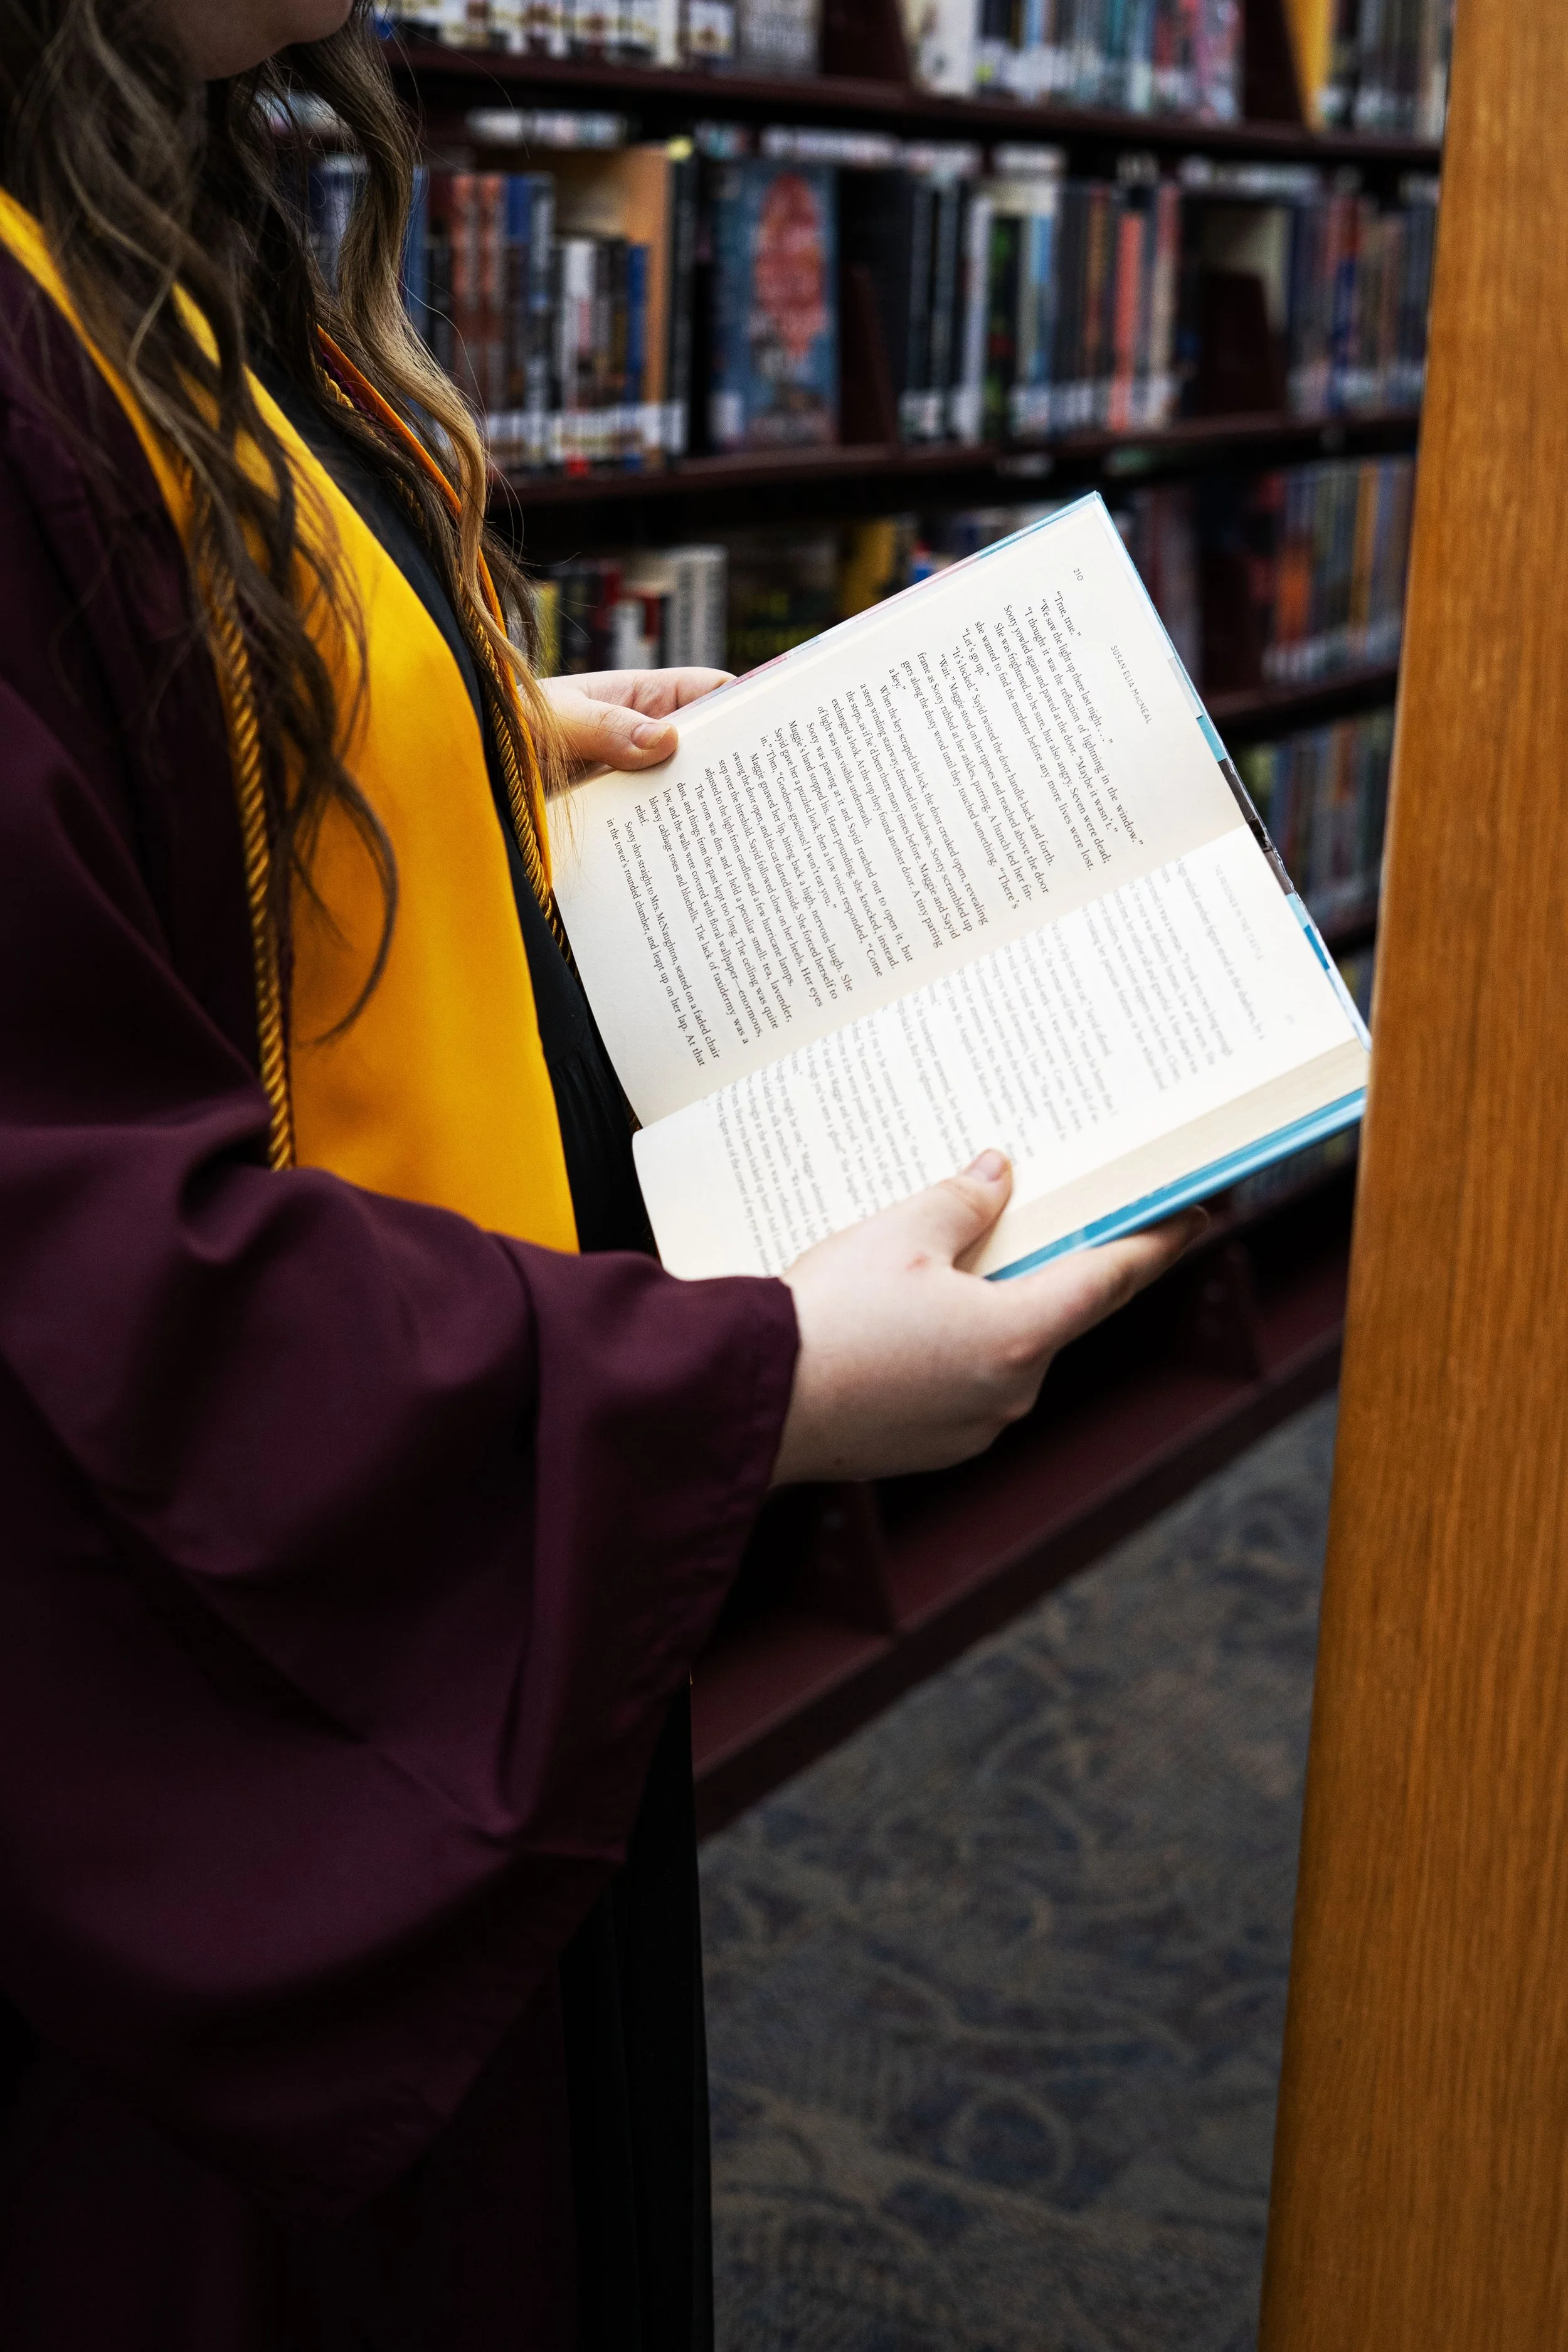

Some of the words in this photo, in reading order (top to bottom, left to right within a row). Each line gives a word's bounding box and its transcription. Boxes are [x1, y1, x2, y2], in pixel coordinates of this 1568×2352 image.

[1073, 568, 1083, 581] 210
[1004, 605, 1017, 627] Sooty
[1024, 607, 1032, 617] “I
[1054, 591, 1066, 618] “True,
[1064, 617, 1081, 636] true.”
[962, 628, 976, 652] “Let’s
[1010, 627, 1032, 654] yowled
[1027, 618, 1046, 647] thought
[968, 652, 979, 662] go
[1042, 647, 1050, 655] it
[974, 662, 989, 676] up.”
[1025, 654, 1040, 674] again
[1040, 598, 1050, 617] “We
[1046, 617, 1056, 631] saw
[1052, 632, 1062, 645] the
[1058, 643, 1071, 662] light
[1066, 662, 1075, 672] up
[1072, 673, 1084, 692] there
[1081, 691, 1091, 706] last
[1087, 706, 1101, 727] night
[1047, 657, 1056, 672] was
[1111, 645, 1126, 669] SUSAN
[1123, 670, 1135, 689] ELIA
[1036, 674, 1049, 689] and
[1054, 674, 1063, 686] the
[817, 706, 828, 714] of
[1039, 688, 1059, 712] pawed
[1060, 687, 1079, 722] reflection
[819, 712, 832, 731] light
[1053, 712, 1061, 721] at
[788, 719, 807, 753] Maggie’s
[1057, 721, 1067, 733] the
[1078, 724, 1089, 733] of
[760, 734, 772, 748] in.”
[828, 731, 837, 746] was
[975, 621, 985, 634] she
[982, 635, 1000, 662] wanted
[993, 663, 1001, 671] to
[998, 672, 1011, 687] find
[1005, 688, 1015, 700] the
[1011, 701, 1030, 734] murderer
[1027, 734, 1042, 761] before
[1039, 763, 1050, 777] any
[1047, 780, 1061, 802] more
[1058, 802, 1072, 824] lives
[1070, 826, 1083, 848] were
[1081, 849, 1093, 871] lost.
[993, 622, 1004, 637] She
[1001, 637, 1011, 653] was
[1007, 652, 1030, 692] frightened,
[1025, 692, 1032, 701] to
[1029, 699, 1037, 711] be
[1034, 711, 1045, 730] sure,
[1042, 728, 1053, 744] but
[1049, 744, 1060, 760] also
[1057, 761, 1072, 787] angry.
[1069, 787, 1085, 814] Seven
[1083, 815, 1096, 837] were
[1094, 838, 1111, 864] dead;
[1063, 734, 1076, 756] door.
[766, 749, 777, 773] Then,
[801, 751, 815, 771] hand
[830, 745, 843, 760] just
[1082, 734, 1104, 773] lightning
[718, 759, 728, 774] step
[839, 760, 854, 784] visible
[939, 654, 955, 680] “Wait.”
[948, 682, 965, 709] Maggie
[960, 709, 976, 730] stood
[969, 730, 977, 741] on
[973, 739, 983, 753] her
[978, 754, 995, 780] tiptoes
[992, 780, 1005, 795] and
[999, 796, 1020, 828] reached
[1014, 829, 1030, 855] above
[1026, 856, 1037, 871] the
[1034, 872, 1049, 893] door
[1076, 755, 1093, 789] “Maybe
[724, 775, 734, 790] over
[808, 772, 827, 801] stopped
[1101, 773, 1110, 785] in
[730, 791, 739, 803] the
[776, 771, 793, 812] “Goodness
[1089, 789, 1098, 798] it
[1107, 787, 1118, 801] the
[820, 800, 830, 815] his.
[849, 784, 872, 828] underneath.
[879, 684, 891, 707] When
[887, 707, 898, 719] the
[893, 718, 902, 732] key
[898, 733, 917, 761] scraped
[910, 761, 919, 773] the
[915, 771, 928, 793] lock,
[924, 793, 933, 805] the
[930, 806, 942, 825] door
[938, 826, 959, 857] creaked
[951, 858, 966, 882] open,
[964, 882, 988, 925] revealing
[606, 818, 614, 827] in
[635, 805, 649, 826] relief.
[734, 803, 754, 839] threshold.
[1094, 798, 1118, 832] wasn’t.”
[1116, 804, 1143, 844] window.”
[610, 828, 619, 840] the
[787, 812, 810, 846] gracious!
[826, 815, 839, 838] Heart
[614, 841, 629, 868] tower’s
[748, 838, 763, 861] Sayid
[832, 838, 855, 879] pounding,
[662, 788, 672, 806] low,
[668, 805, 680, 820] and
[674, 820, 682, 832] the
[678, 832, 691, 851] walls
[685, 851, 695, 870] were
[691, 870, 709, 899] covered
[702, 899, 715, 918] with
[709, 918, 724, 940] floral
[806, 851, 820, 874] won’t
[623, 869, 641, 899] rounded
[756, 860, 776, 894] followed
[815, 875, 824, 887] eat
[852, 879, 862, 893] she
[770, 894, 781, 914] close
[817, 887, 837, 908] you.”
[635, 901, 650, 935] chamber,
[778, 915, 787, 926] on
[859, 893, 882, 934] knocked,
[647, 935, 659, 950] and
[783, 925, 793, 941] her
[652, 950, 664, 972] leapt
[789, 940, 804, 967] heels.
[877, 933, 899, 969] instead.
[659, 972, 669, 983] up
[800, 967, 813, 985] Her
[665, 985, 674, 997] on
[808, 987, 822, 1007] eyes
[670, 997, 681, 1012] her
[677, 1014, 687, 1031] lap.
[686, 1035, 695, 1046] At
[692, 1047, 705, 1066] that
